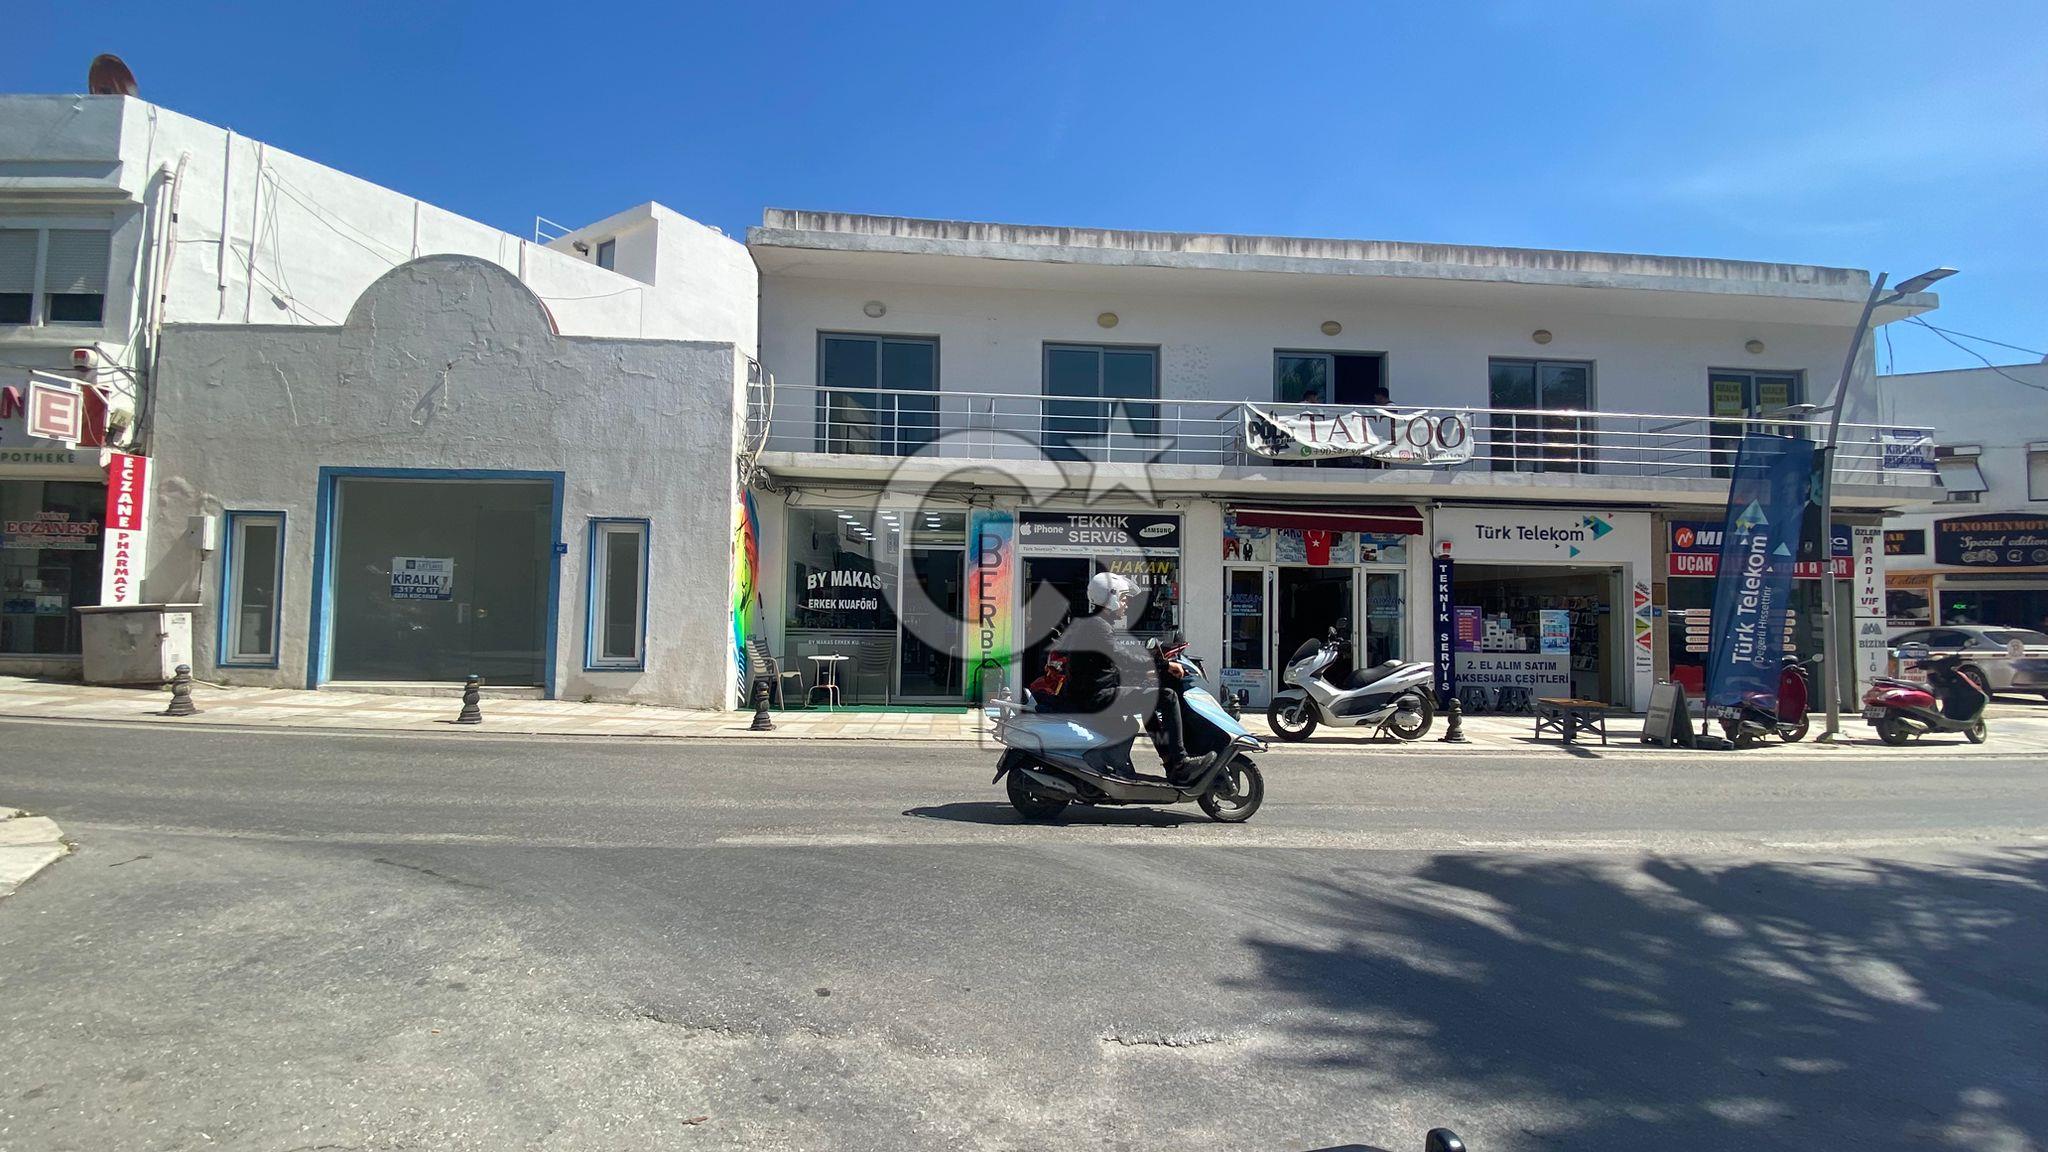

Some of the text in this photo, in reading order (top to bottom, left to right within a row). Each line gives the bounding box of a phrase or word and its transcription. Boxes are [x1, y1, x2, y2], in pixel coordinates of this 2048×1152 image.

[1300, 409, 1466, 449] TATTOO
[117, 457, 134, 528] ECZANE
[6, 519, 99, 535] ECZANESİ
[1033, 524, 1064, 534] iPhone
[1475, 525, 1584, 541] Türk Telekom
[1960, 535, 2048, 551] Special edition
[113, 532, 130, 603] PHARMACY
[1110, 561, 1169, 573] HAKAN
[1677, 556, 1713, 574] UÇAK
[393, 572, 439, 585] KİRALIK
[807, 570, 881, 590] BY MAKAS
[1737, 536, 1768, 616] Telekom
[1439, 565, 1449, 622] TEKNİK
[808, 597, 878, 610] ERKEK KUAFÖRÜ
[1731, 622, 1756, 664] Türk
[1859, 639, 1887, 649] BİZİM
[1441, 633, 1450, 690] SERVİS
[1467, 661, 1557, 671] 2. EL ALIM SATIM
[1455, 671, 1568, 685] AKSESUAR ÇEŞİTLERİ
